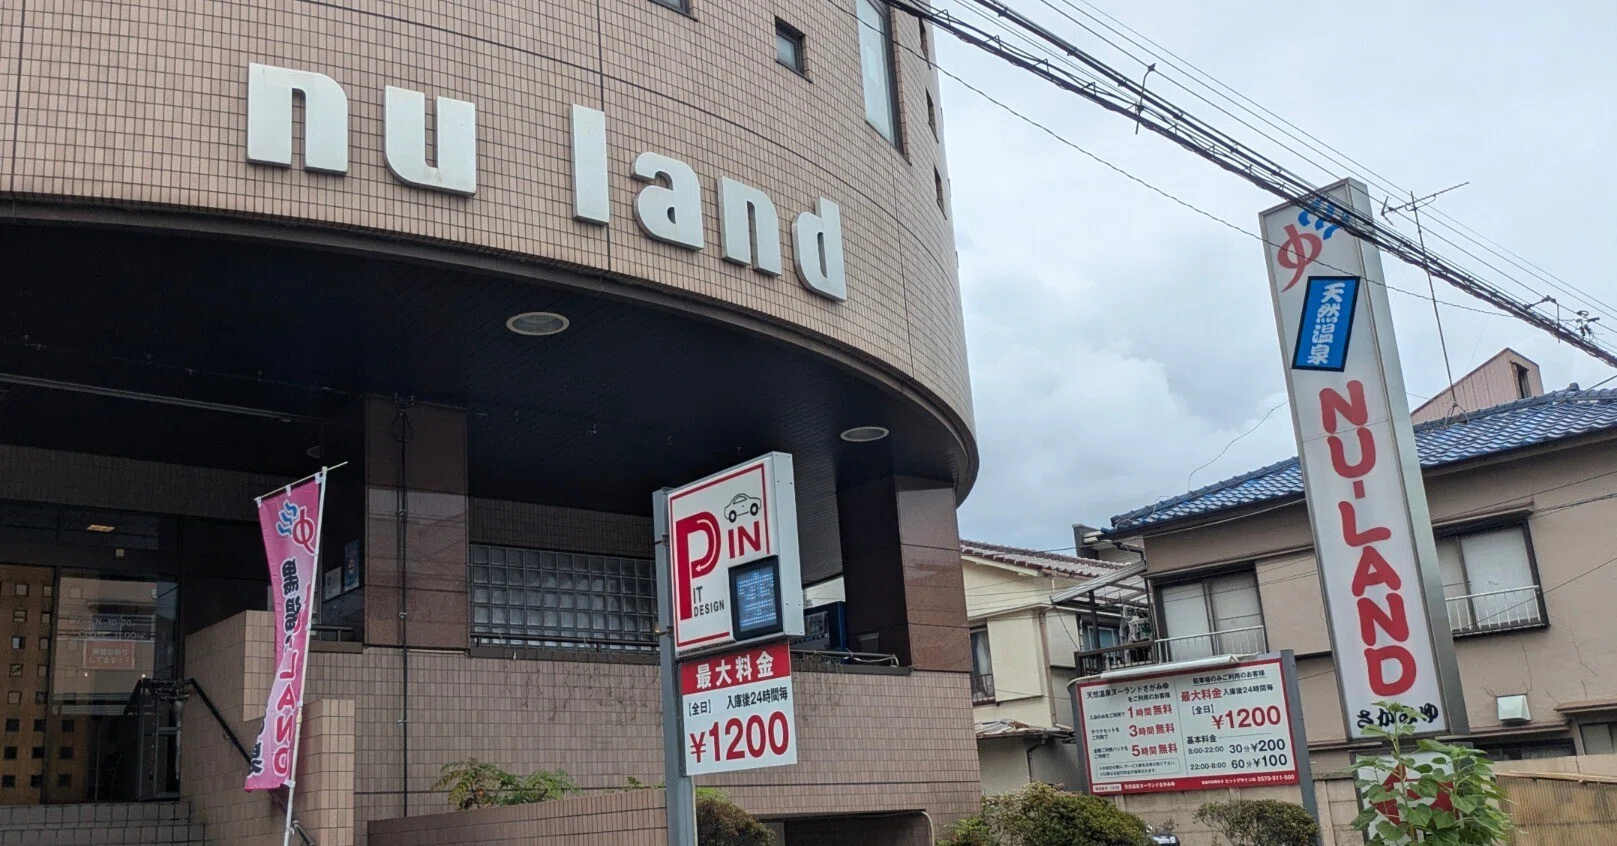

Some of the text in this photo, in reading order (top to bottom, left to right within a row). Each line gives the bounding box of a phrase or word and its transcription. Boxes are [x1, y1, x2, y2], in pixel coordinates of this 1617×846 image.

[247, 62, 848, 302] nu land
[1307, 282, 1346, 365] 天然温泉
[728, 521, 761, 559] IN
[1319, 379, 1417, 697] NU-LAND
[693, 599, 725, 618] DESIGN
[696, 650, 774, 689] 最大料金
[1192, 669, 1265, 684] 駐車場のみご利用のお客様
[726, 686, 788, 710] 入庫後24時間毎
[1086, 682, 1170, 699] 天然温泉ヌーランドさがみゆ
[1128, 691, 1171, 703] をご利用のお客様
[1181, 684, 1273, 702] 最大料金 入庫後24時間毎
[1212, 705, 1281, 730] ¥1200
[690, 710, 789, 763] ¥1200
[1187, 734, 1217, 744] 基本料金
[1188, 745, 1224, 755] 8:00-22:00
[1190, 761, 1227, 771] 22:00-8:00
